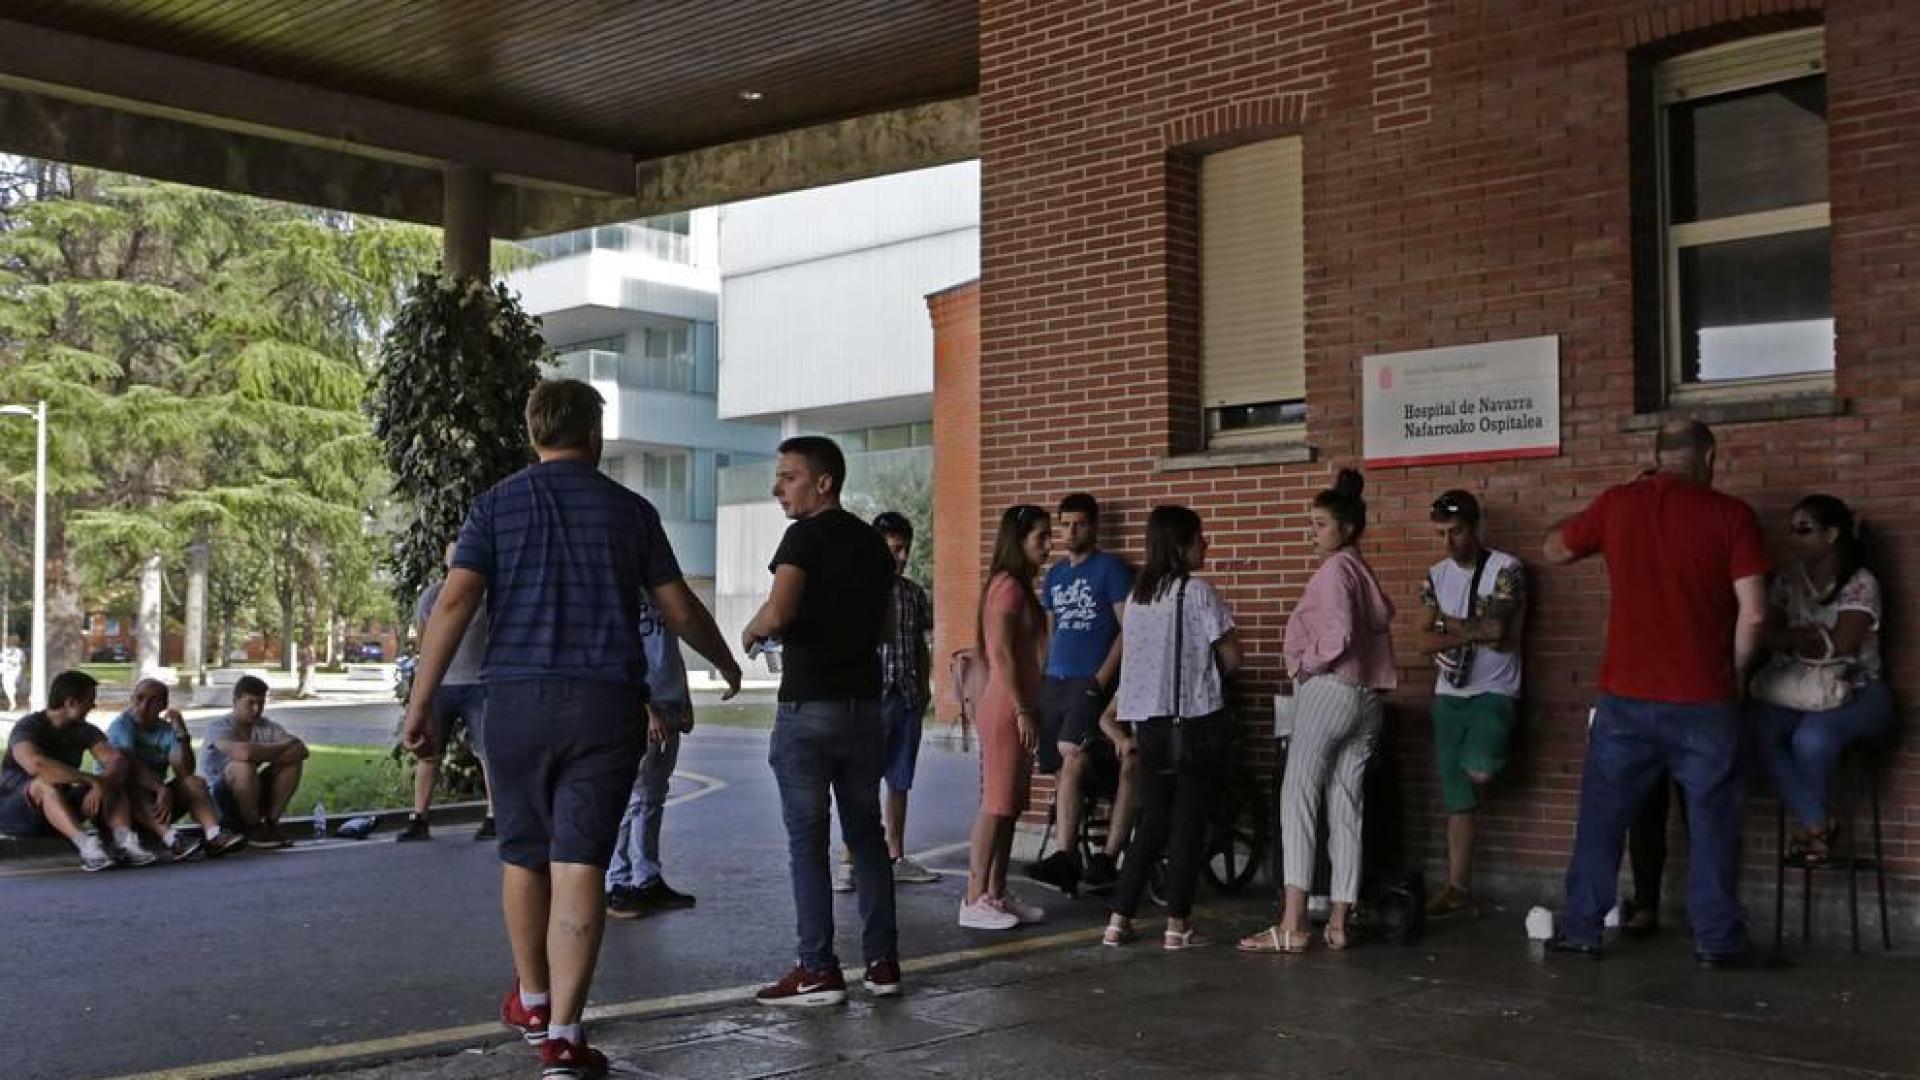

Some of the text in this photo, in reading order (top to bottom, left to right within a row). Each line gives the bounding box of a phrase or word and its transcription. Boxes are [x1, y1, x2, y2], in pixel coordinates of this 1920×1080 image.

[1404, 396, 1533, 420] Hospital de Navarra
[1404, 413, 1543, 439] Nafarroako Ospitalea
